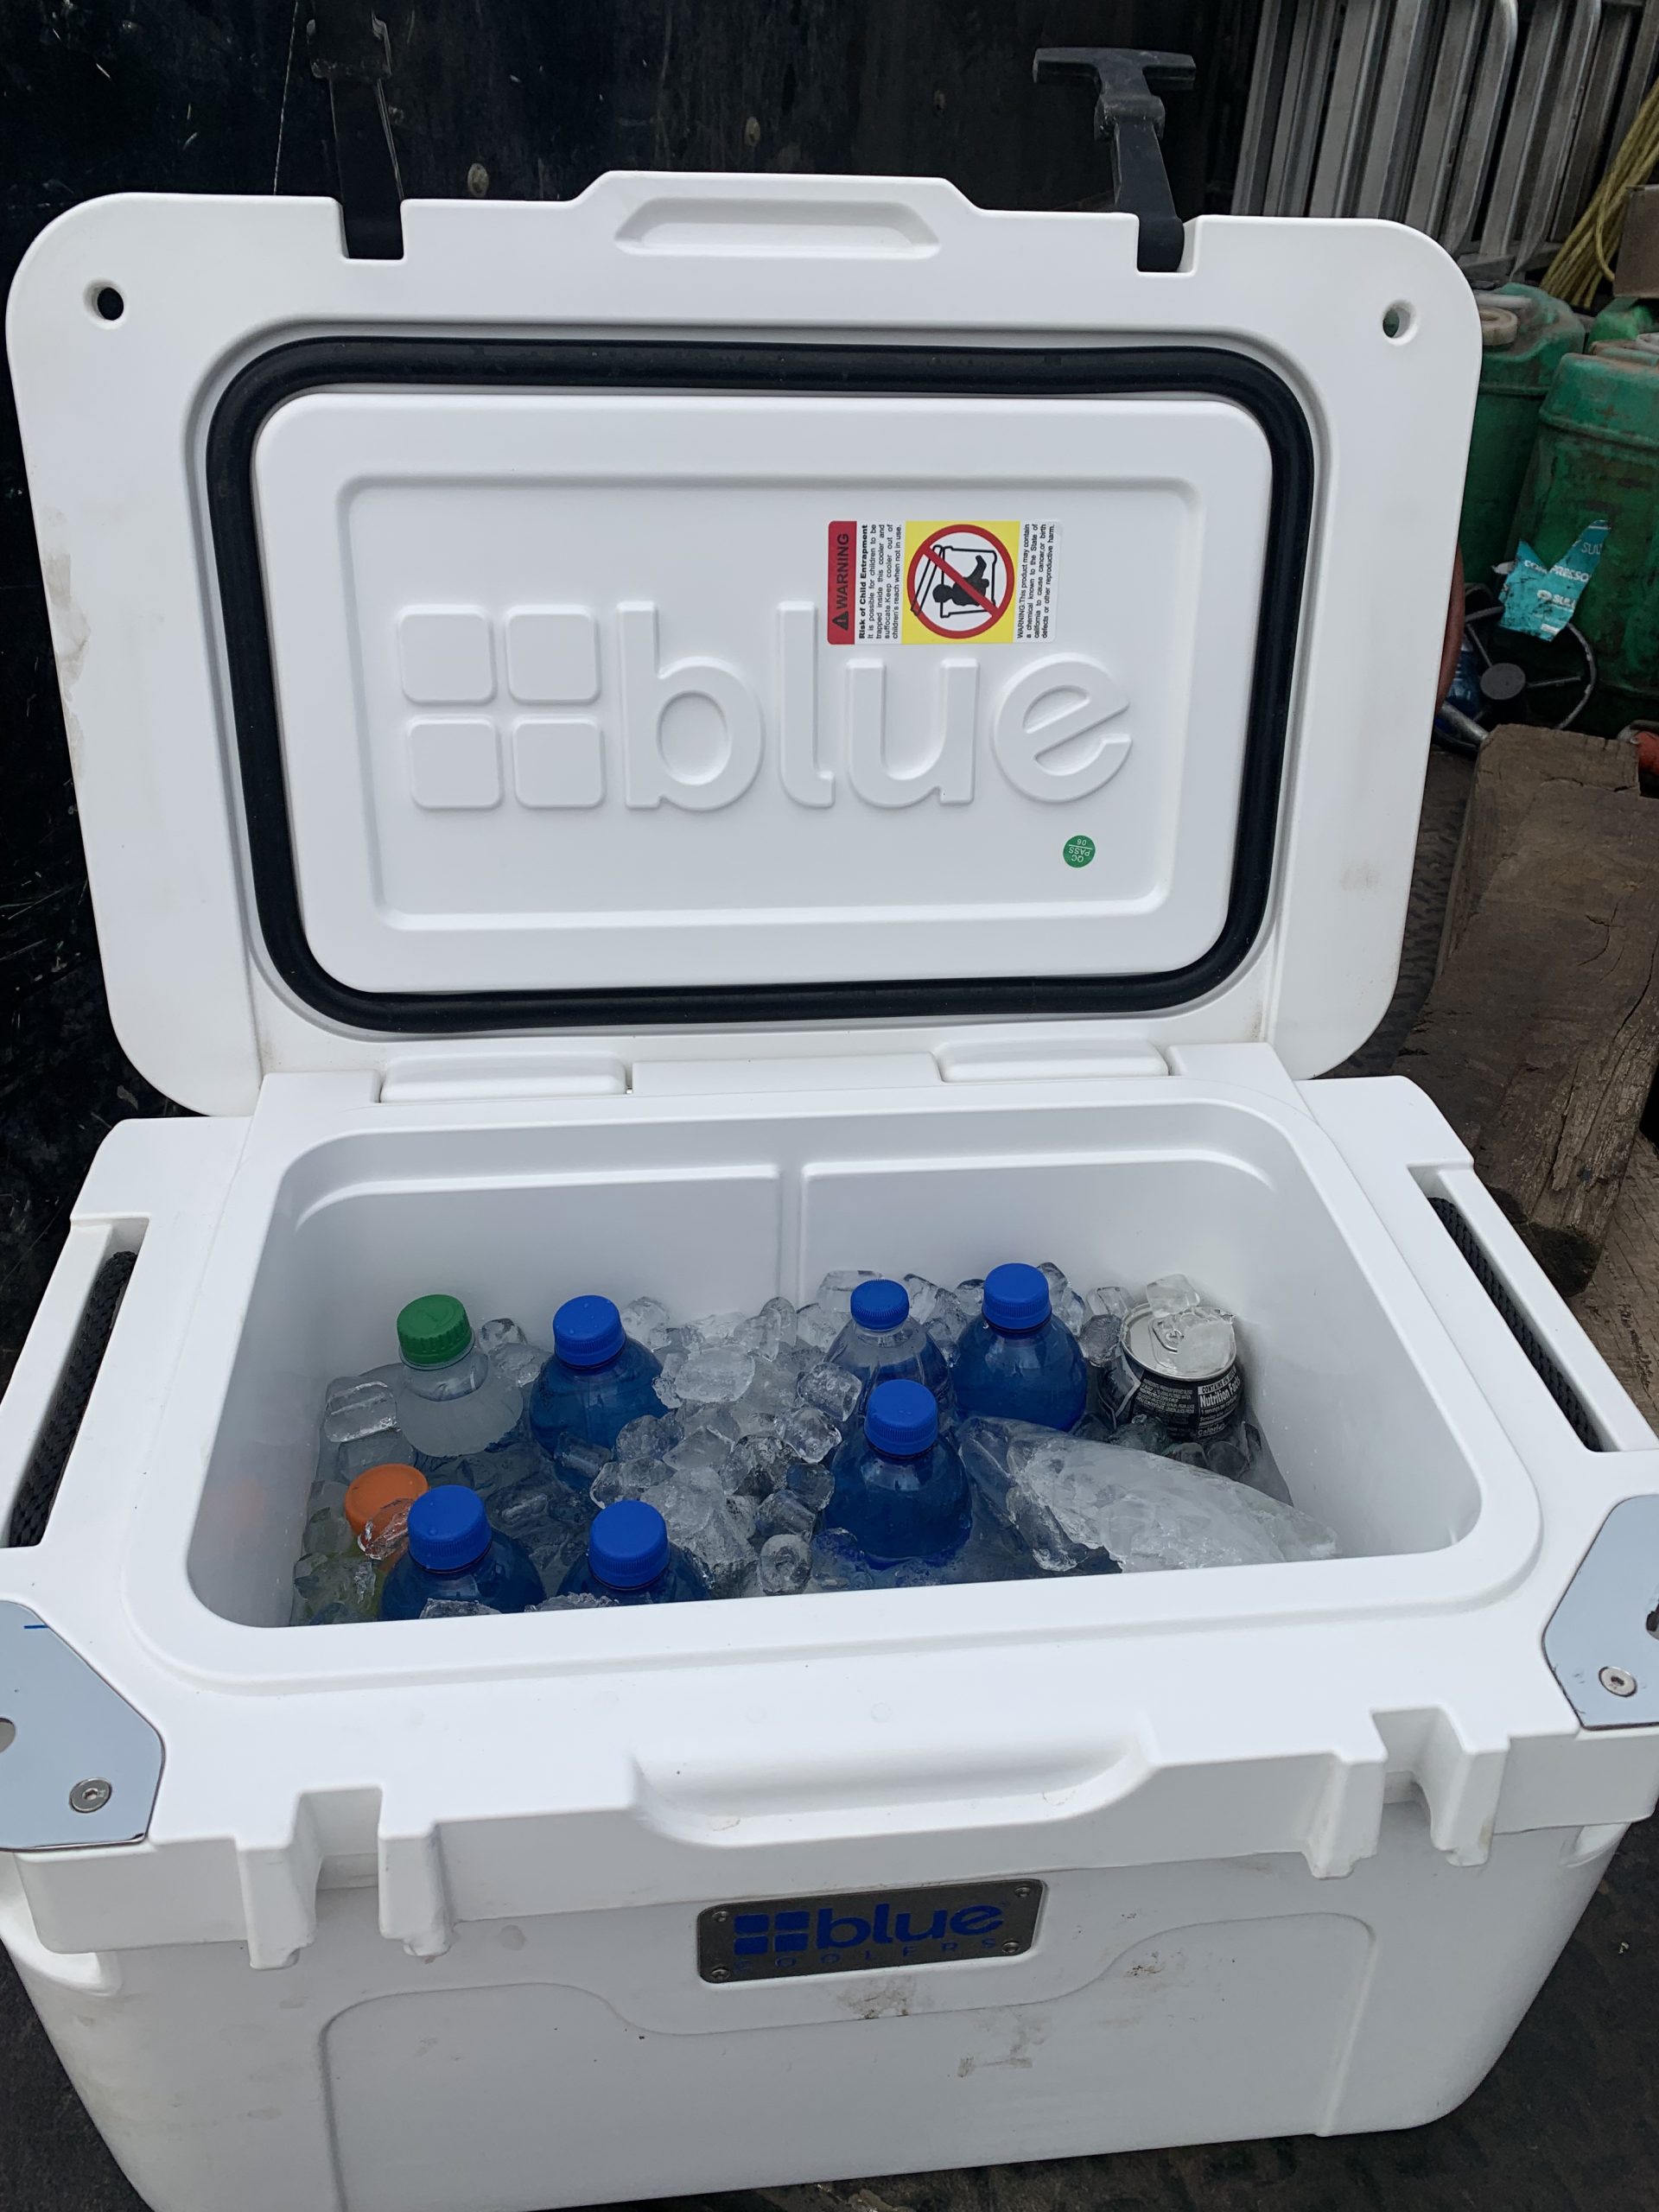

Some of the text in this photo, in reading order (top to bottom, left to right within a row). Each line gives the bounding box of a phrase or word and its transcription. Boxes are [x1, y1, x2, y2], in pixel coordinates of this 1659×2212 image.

[870, 524, 877, 534] be
[887, 524, 893, 532] of
[836, 533, 849, 609] WARNING
[860, 607, 866, 617] of
[617, 601, 1133, 812] blue
[1068, 847, 1090, 856] PASS
[1199, 1389, 1230, 1408] Nutrition
[1228, 1375, 1241, 1395] Facts
[817, 1904, 1003, 1950] blue
